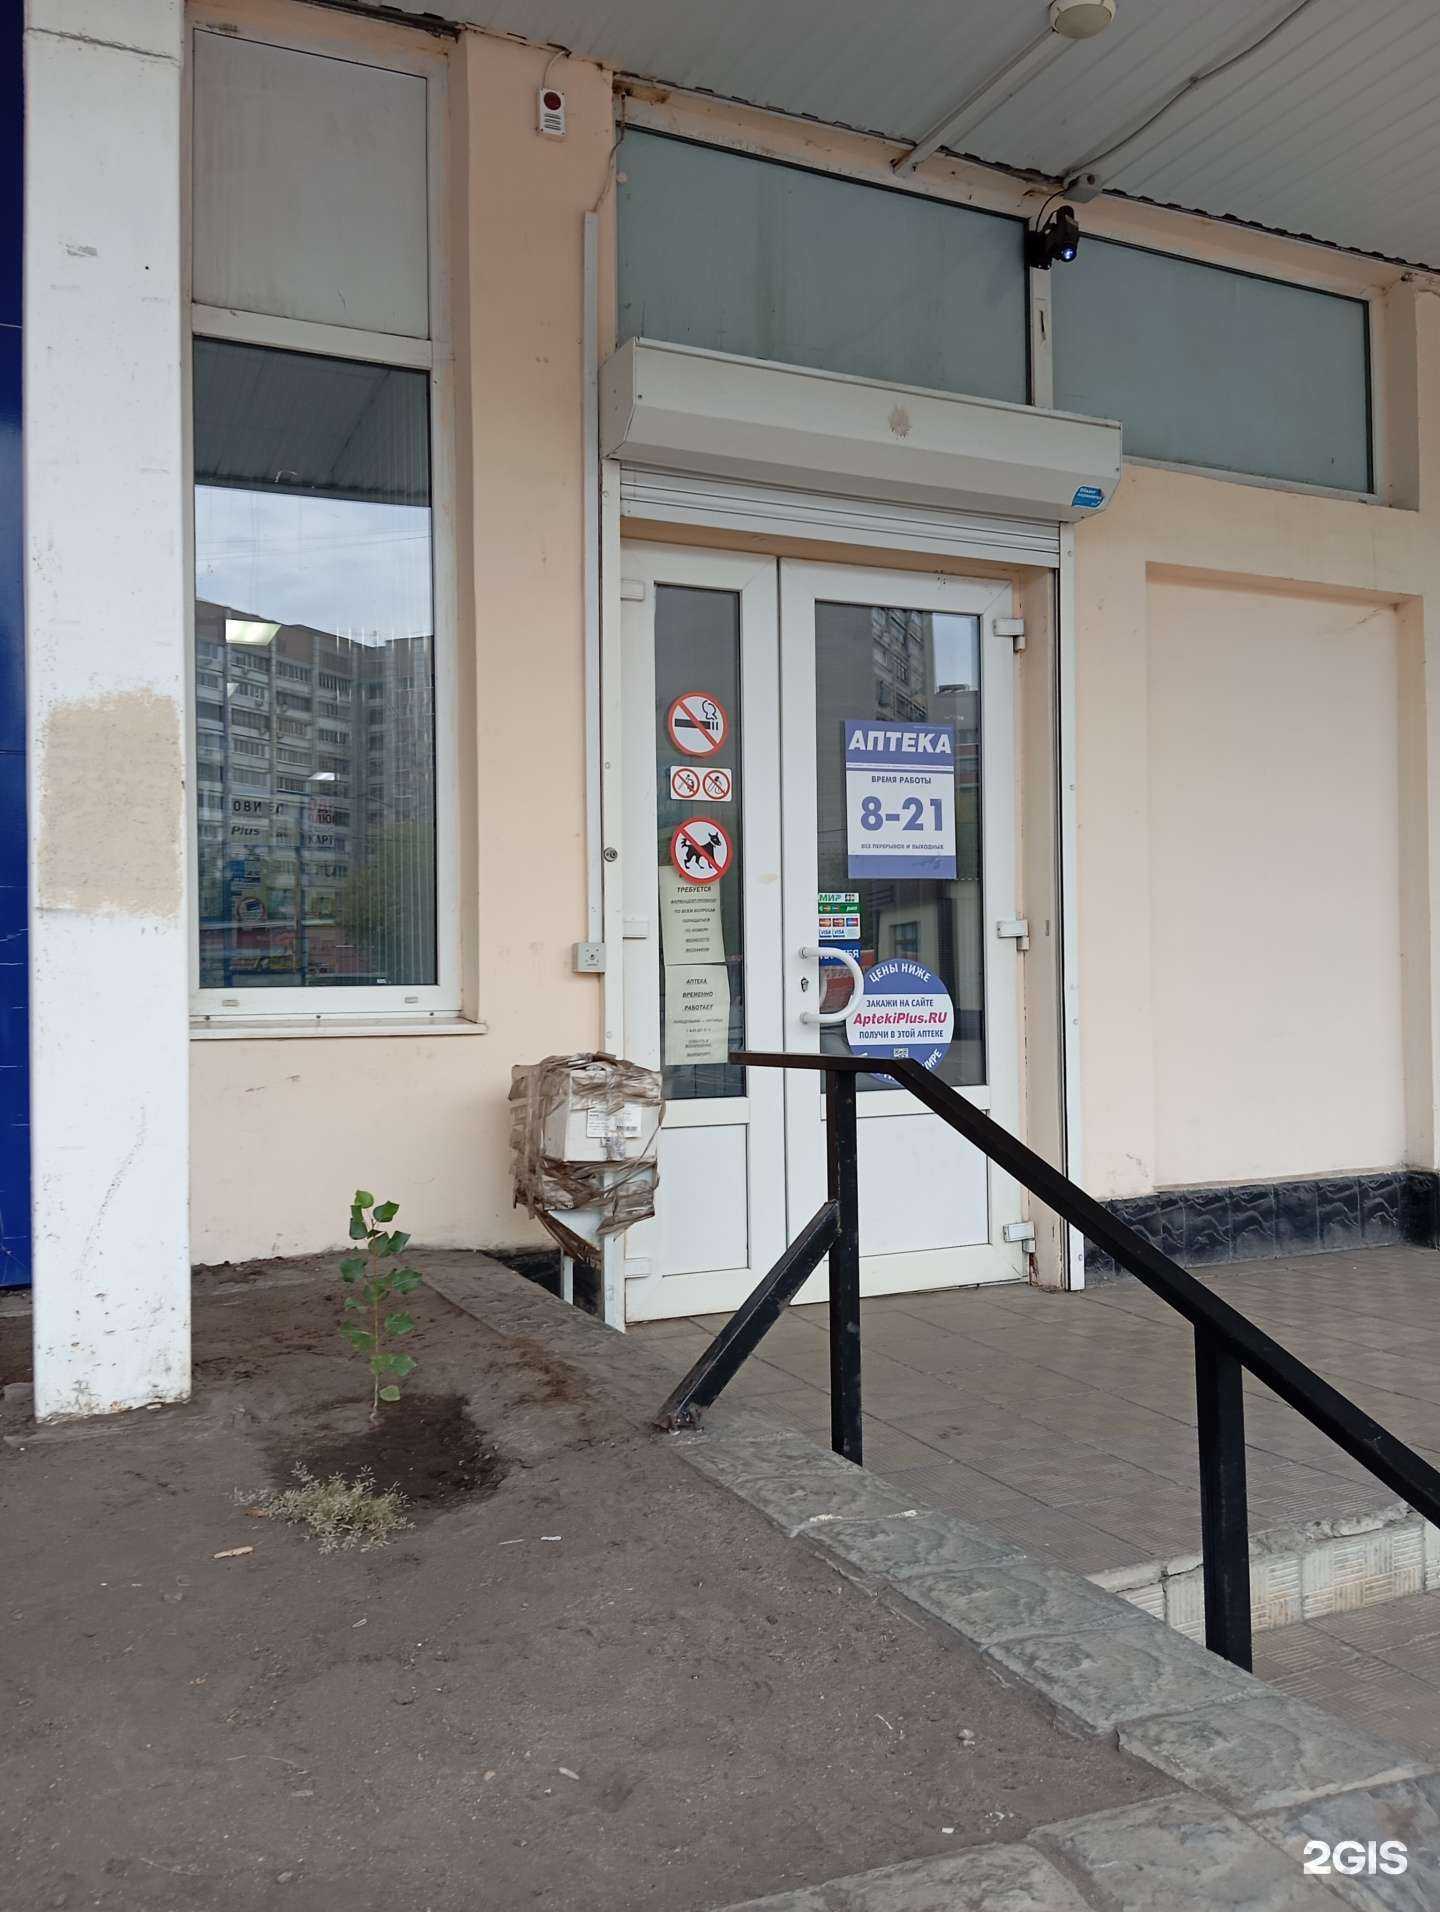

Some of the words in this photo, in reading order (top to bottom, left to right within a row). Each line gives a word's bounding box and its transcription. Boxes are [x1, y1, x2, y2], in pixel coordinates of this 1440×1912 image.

[848, 729, 952, 754] АПТЕКА
[871, 775, 897, 784] ВРЕМЯ
[899, 776, 932, 785] РАБОТЫ
[860, 795, 943, 832] 8-21
[869, 963, 899, 983] ЦЕНЫ
[901, 963, 932, 983] НИЖЕ
[866, 999, 898, 1008] ЗАКАЖИ
[899, 999, 910, 1007] НА
[911, 996, 935, 1007] САЙТЕ
[853, 1012, 948, 1027] AptekiPlus.RU
[858, 1030, 889, 1040] ПОЛУЧИ
[890, 1030, 896, 1039] В
[897, 1027, 916, 1039] ЭТОЙ
[917, 1029, 945, 1038] АПТЕКЕ
